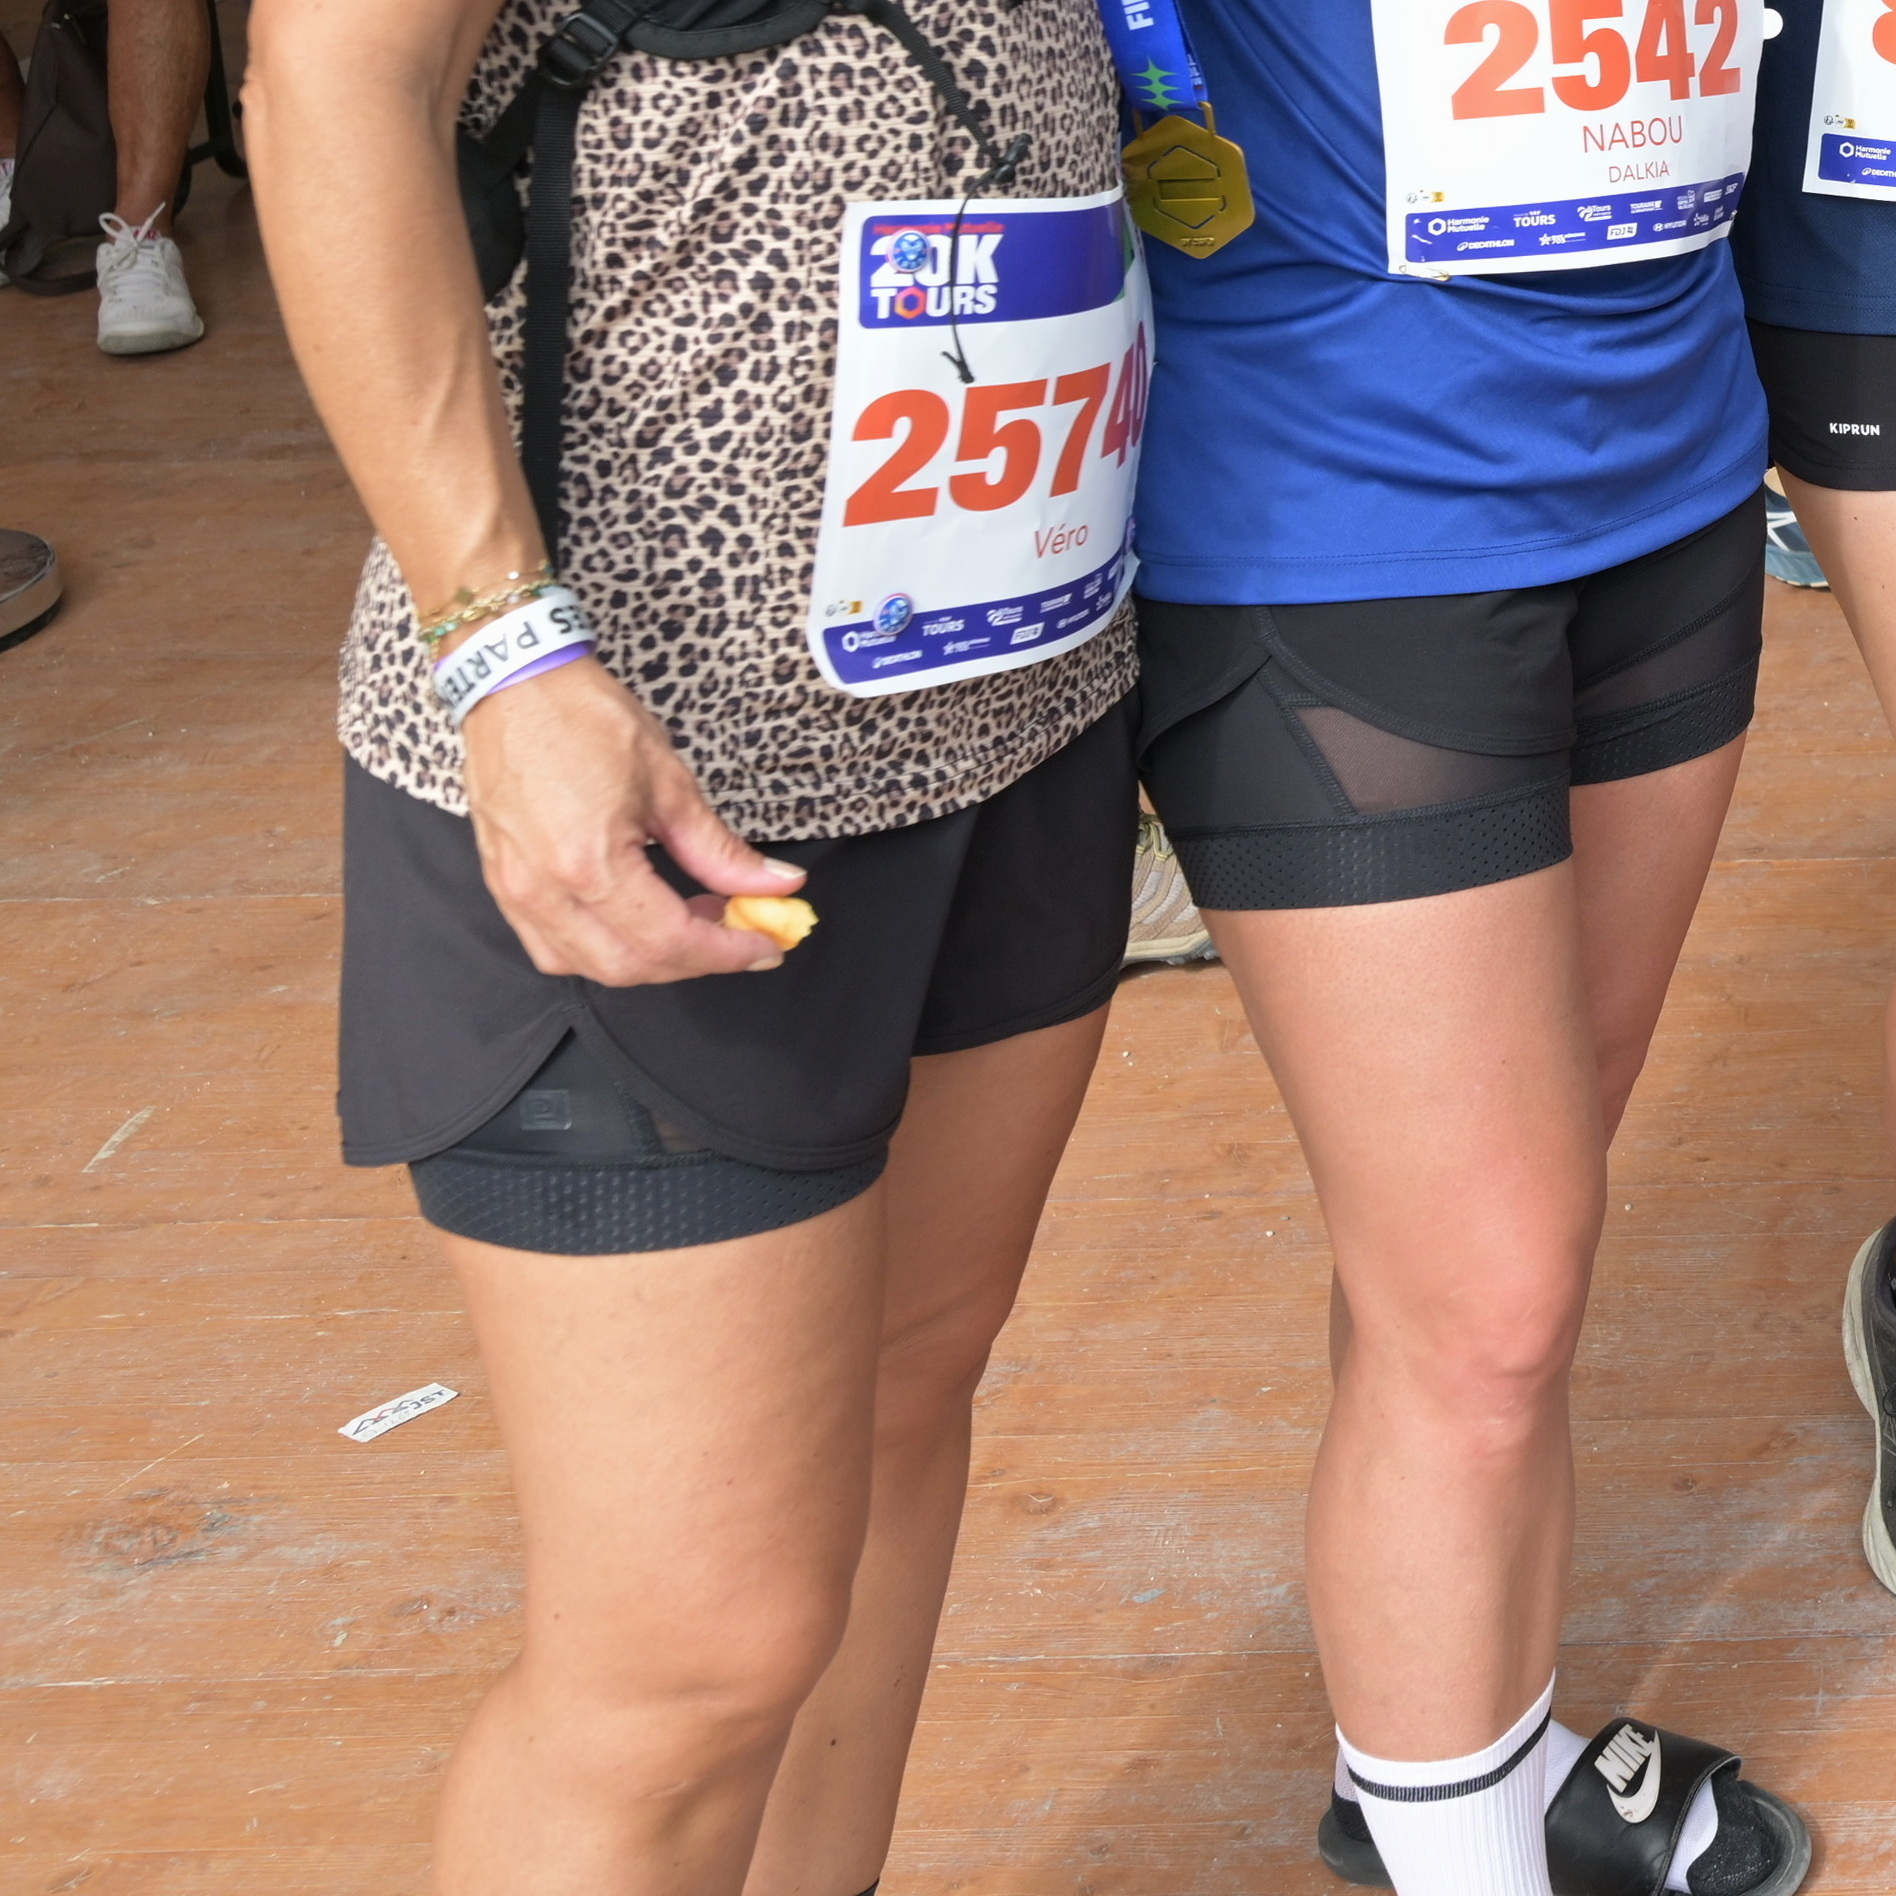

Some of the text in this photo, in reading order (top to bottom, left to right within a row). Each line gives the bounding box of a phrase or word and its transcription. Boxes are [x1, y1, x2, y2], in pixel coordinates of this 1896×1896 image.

[1582, 115, 1683, 153] NABOU
[1856, 145, 1891, 155] Harmonie
[1608, 160, 1670, 183] DALKIA
[1447, 215, 1490, 227] Harmonie
[1513, 214, 1556, 228] TOURS
[1468, 239, 1515, 251] DECATHLON
[870, 234, 1004, 288] 20K
[870, 284, 998, 320] TOURS
[842, 319, 1148, 528] 25740
[1829, 422, 1881, 436] KIPRUN
[1034, 524, 1089, 559] Véro
[922, 619, 965, 637] TOURS
[1594, 1723, 1655, 1794] NIKE
